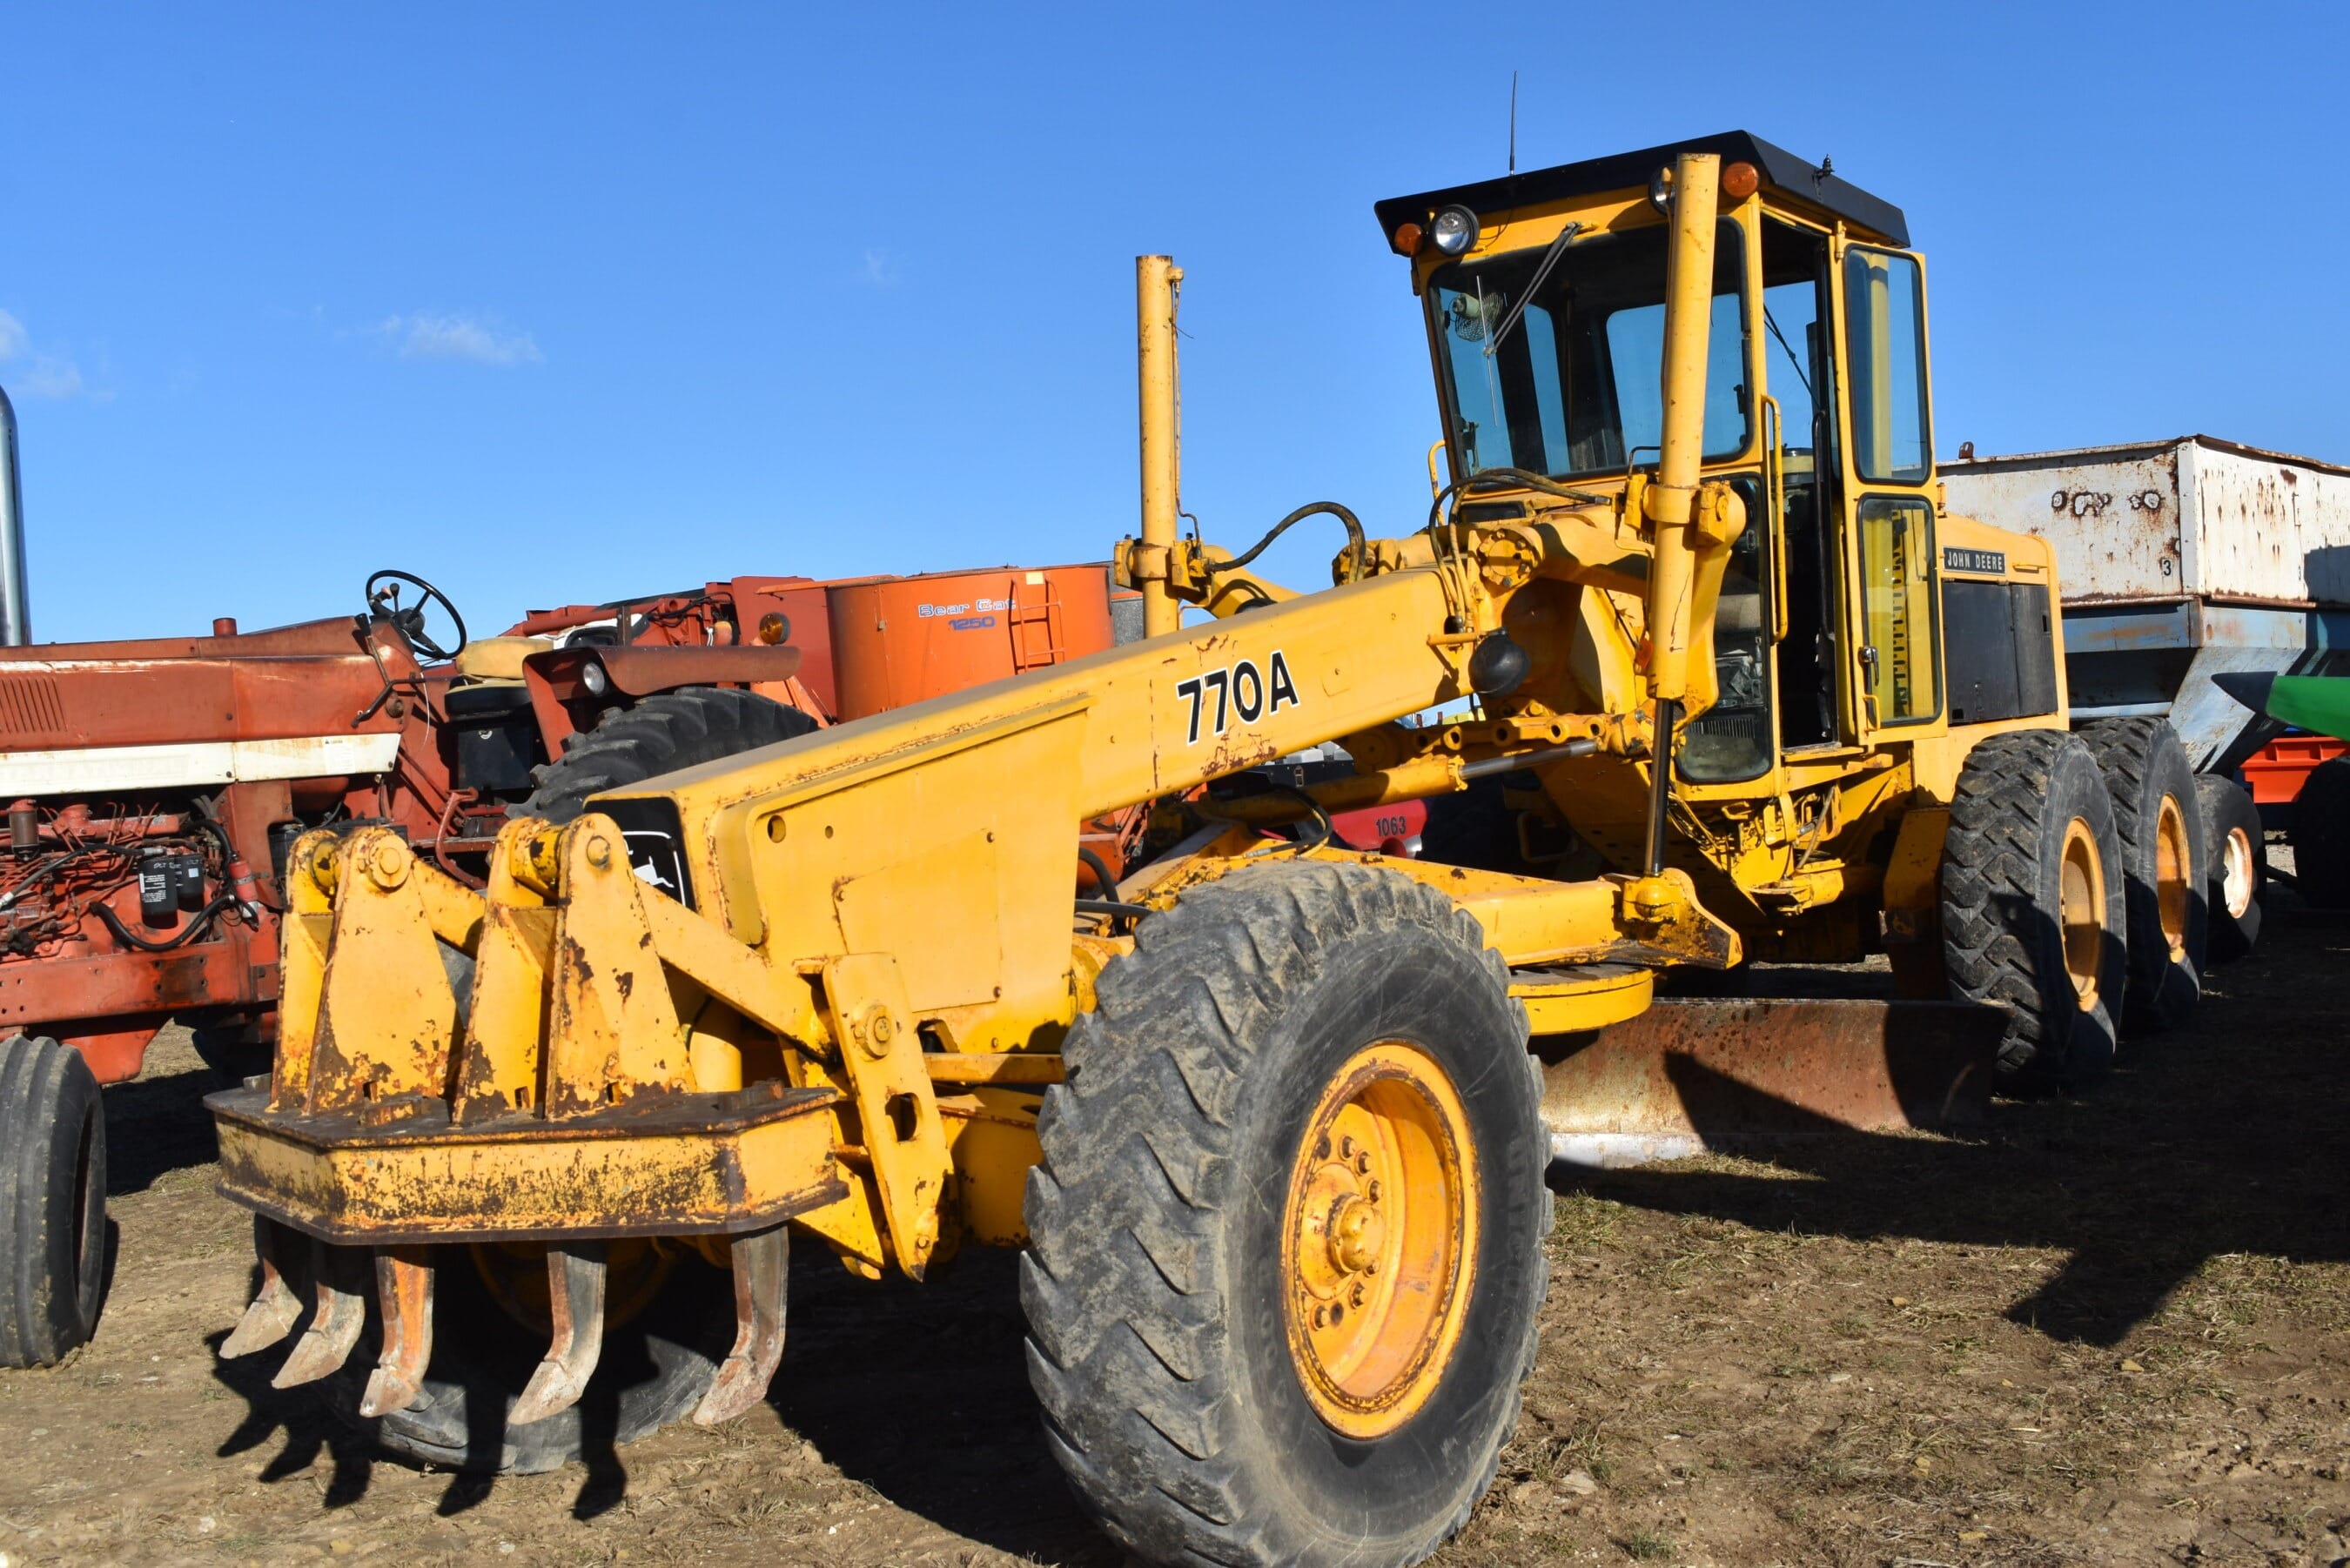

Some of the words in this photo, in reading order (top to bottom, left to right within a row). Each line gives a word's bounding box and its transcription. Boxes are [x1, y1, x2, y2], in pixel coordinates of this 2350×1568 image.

[1947, 551, 1971, 568] JOHN
[1975, 553, 2003, 571] DEERE
[2163, 560, 2172, 576] 3
[918, 605, 970, 617] Bear
[977, 599, 1017, 612] Cat
[949, 616, 997, 631] 1250
[1177, 649, 1299, 745] 770A
[1376, 816, 1407, 836] 1063
